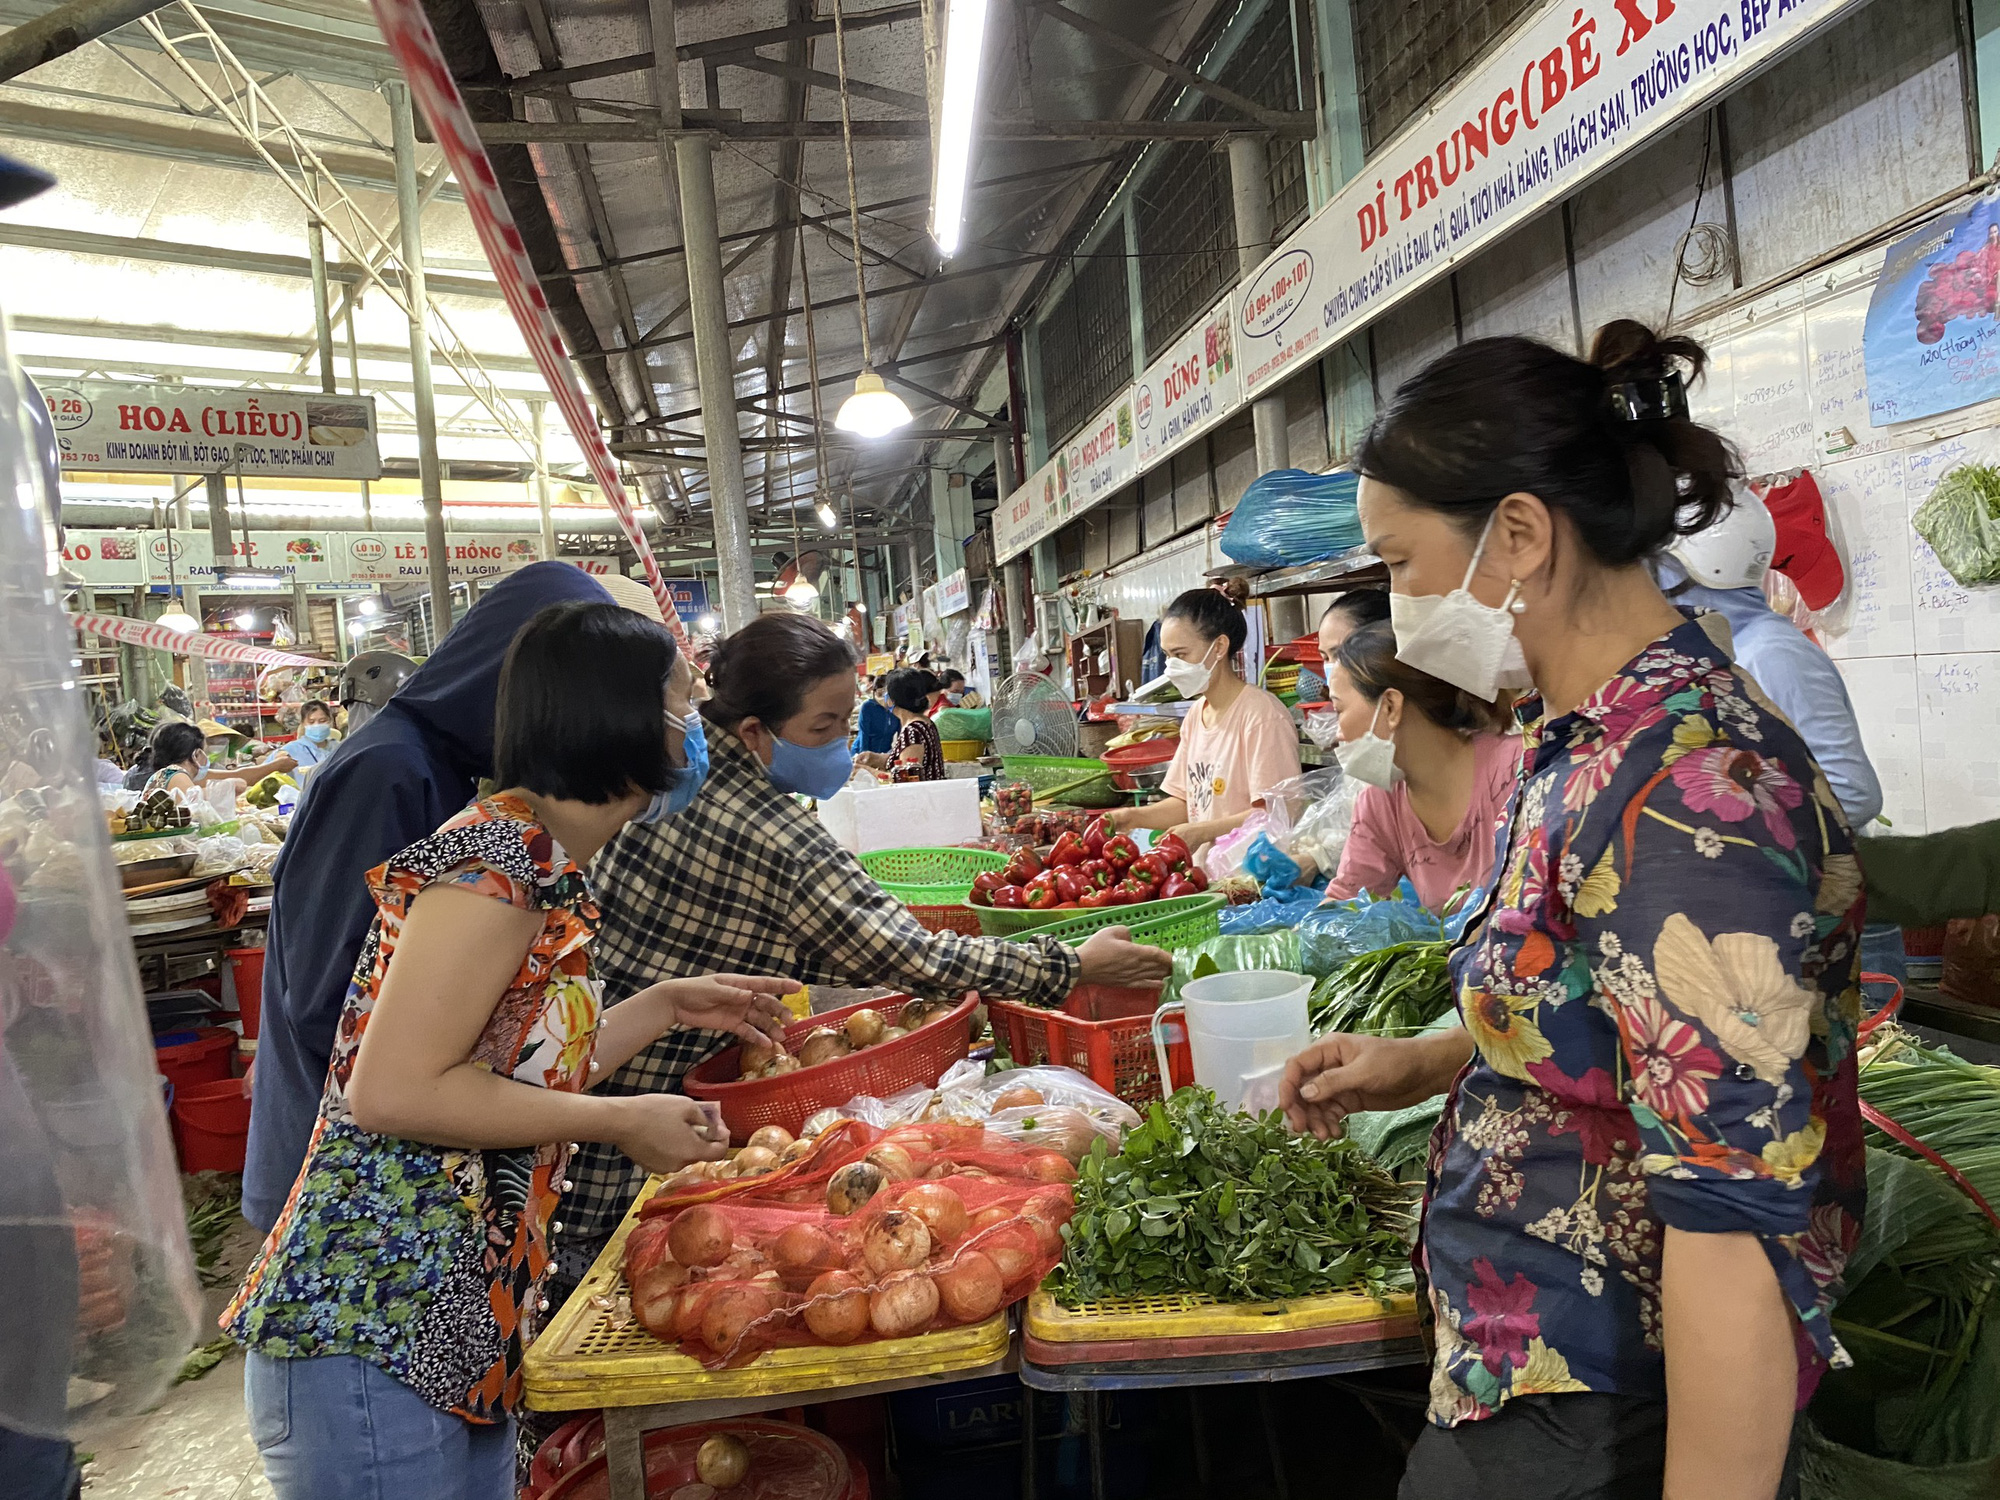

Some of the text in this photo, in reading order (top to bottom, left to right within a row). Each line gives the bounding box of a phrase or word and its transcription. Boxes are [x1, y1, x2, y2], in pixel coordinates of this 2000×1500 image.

[1350, 275, 1368, 311] CUNG
[1450, 191, 1470, 242] QUẢ
[1494, 161, 1516, 212] NHÀ
[1554, 110, 1598, 171] KHÁCH
[1631, 43, 1691, 118] TRƯỜNG
[1694, 12, 1738, 77] HỌC,
[1262, 298, 1294, 328] TAM GIÁC
[1163, 354, 1200, 409] DŨNG
[46, 394, 82, 414] Ô 26
[117, 397, 303, 441] HOA (LIỄU)
[81, 453, 100, 462] 703
[106, 441, 128, 460] KINH
[129, 443, 160, 461] DOANH
[161, 439, 178, 466] BỘT
[193, 441, 209, 466] BỘT
[291, 441, 313, 465] PHẨM
[315, 451, 335, 467] CHAY
[370, 544, 381, 552] 10
[394, 539, 503, 562] LÊ TỊ HỒNG
[189, 566, 214, 575] RAU
[399, 566, 422, 575] RAU
[466, 565, 501, 576] LAGIM
